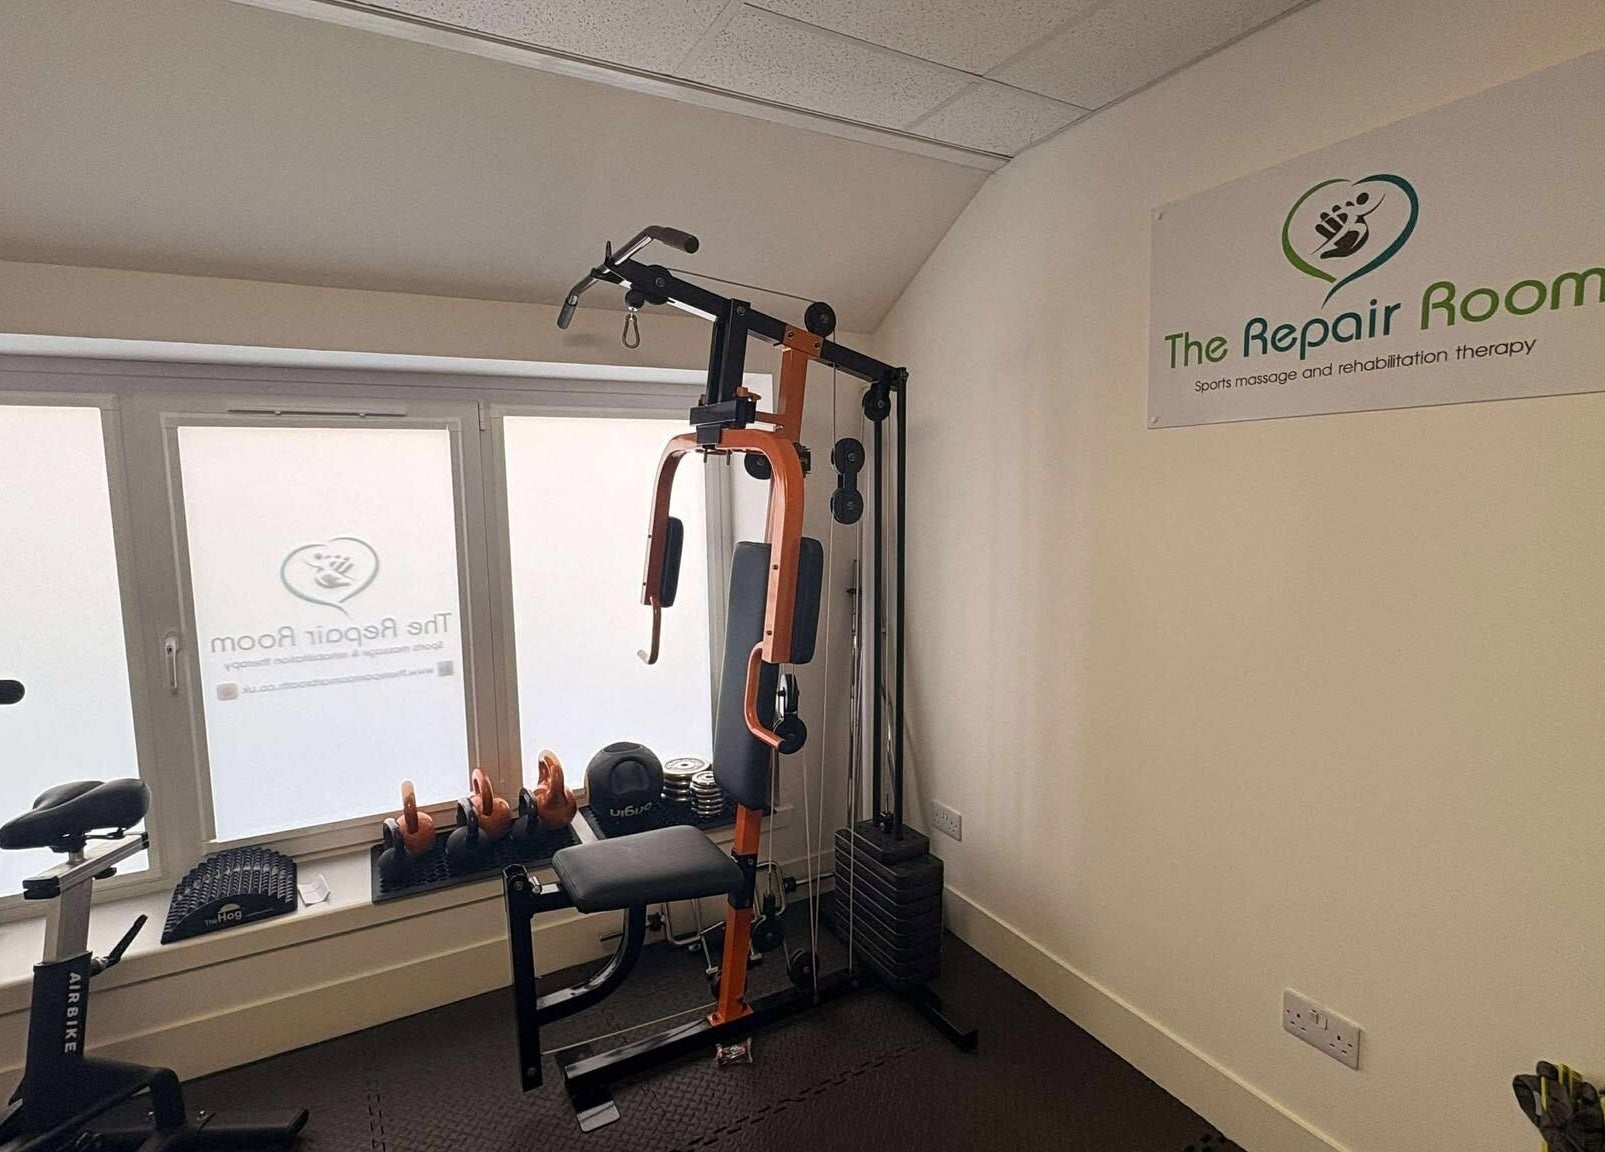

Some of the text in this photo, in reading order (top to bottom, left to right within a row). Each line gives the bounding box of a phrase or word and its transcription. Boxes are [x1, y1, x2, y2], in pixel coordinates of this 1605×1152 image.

[1165, 267, 1605, 368] The Repair Room
[1194, 338, 1537, 393] Sports massage and rehabilitation therapy
[217, 911, 242, 923] Hog
[64, 972, 81, 1053] AIRBIKE
